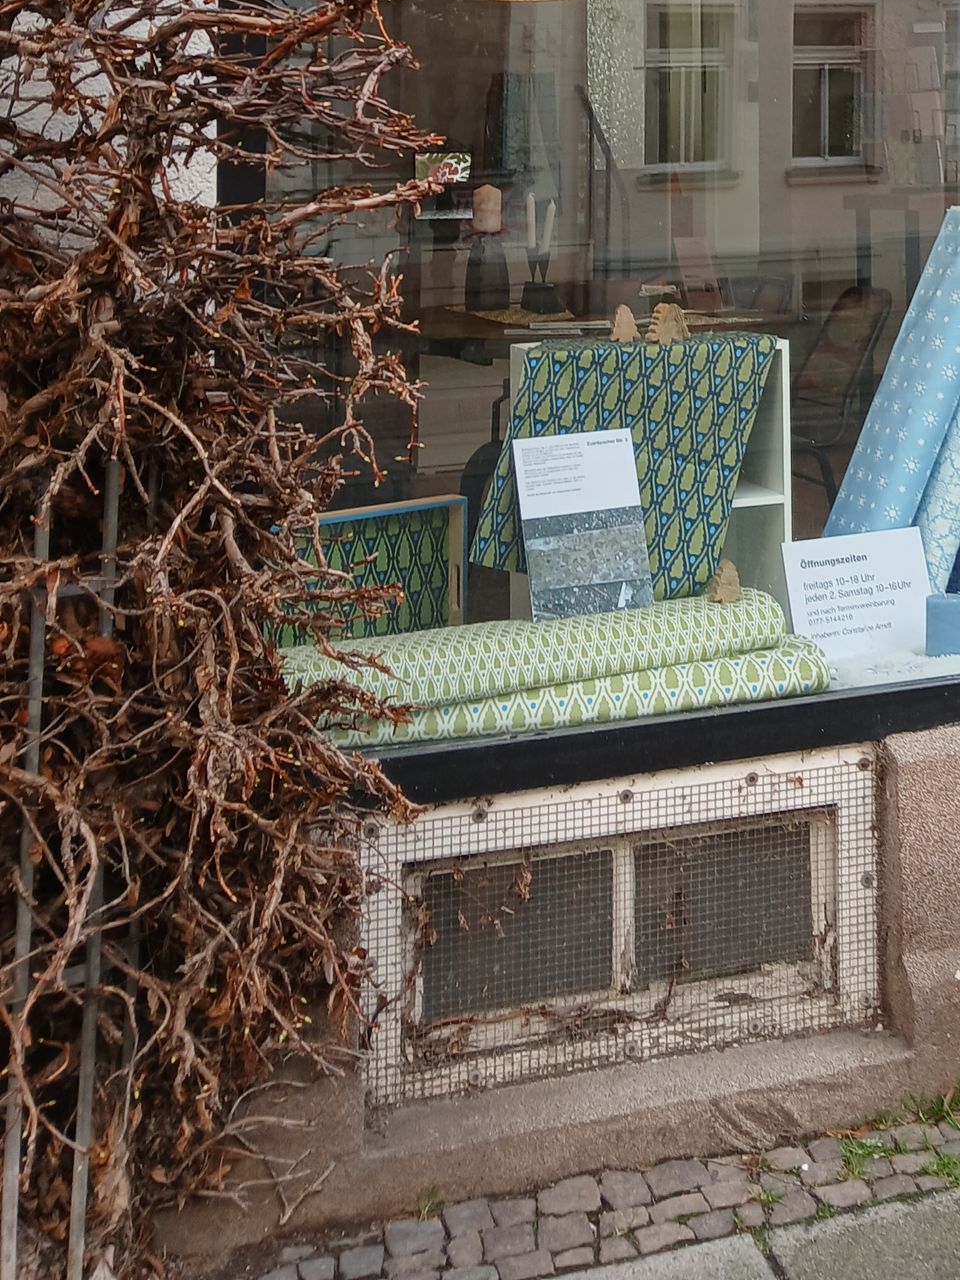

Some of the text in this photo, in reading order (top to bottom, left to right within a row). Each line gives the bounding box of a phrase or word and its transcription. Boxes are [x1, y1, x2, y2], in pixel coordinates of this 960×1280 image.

[800, 554, 868, 569] Öffnungszeiten
[803, 579, 833, 591] freitags
[860, 573, 875, 583] Uhr
[804, 593, 828, 605] jeden
[829, 591, 837, 600] 2.
[837, 586, 873, 599] Samstag
[897, 580, 912, 590] Uhr
